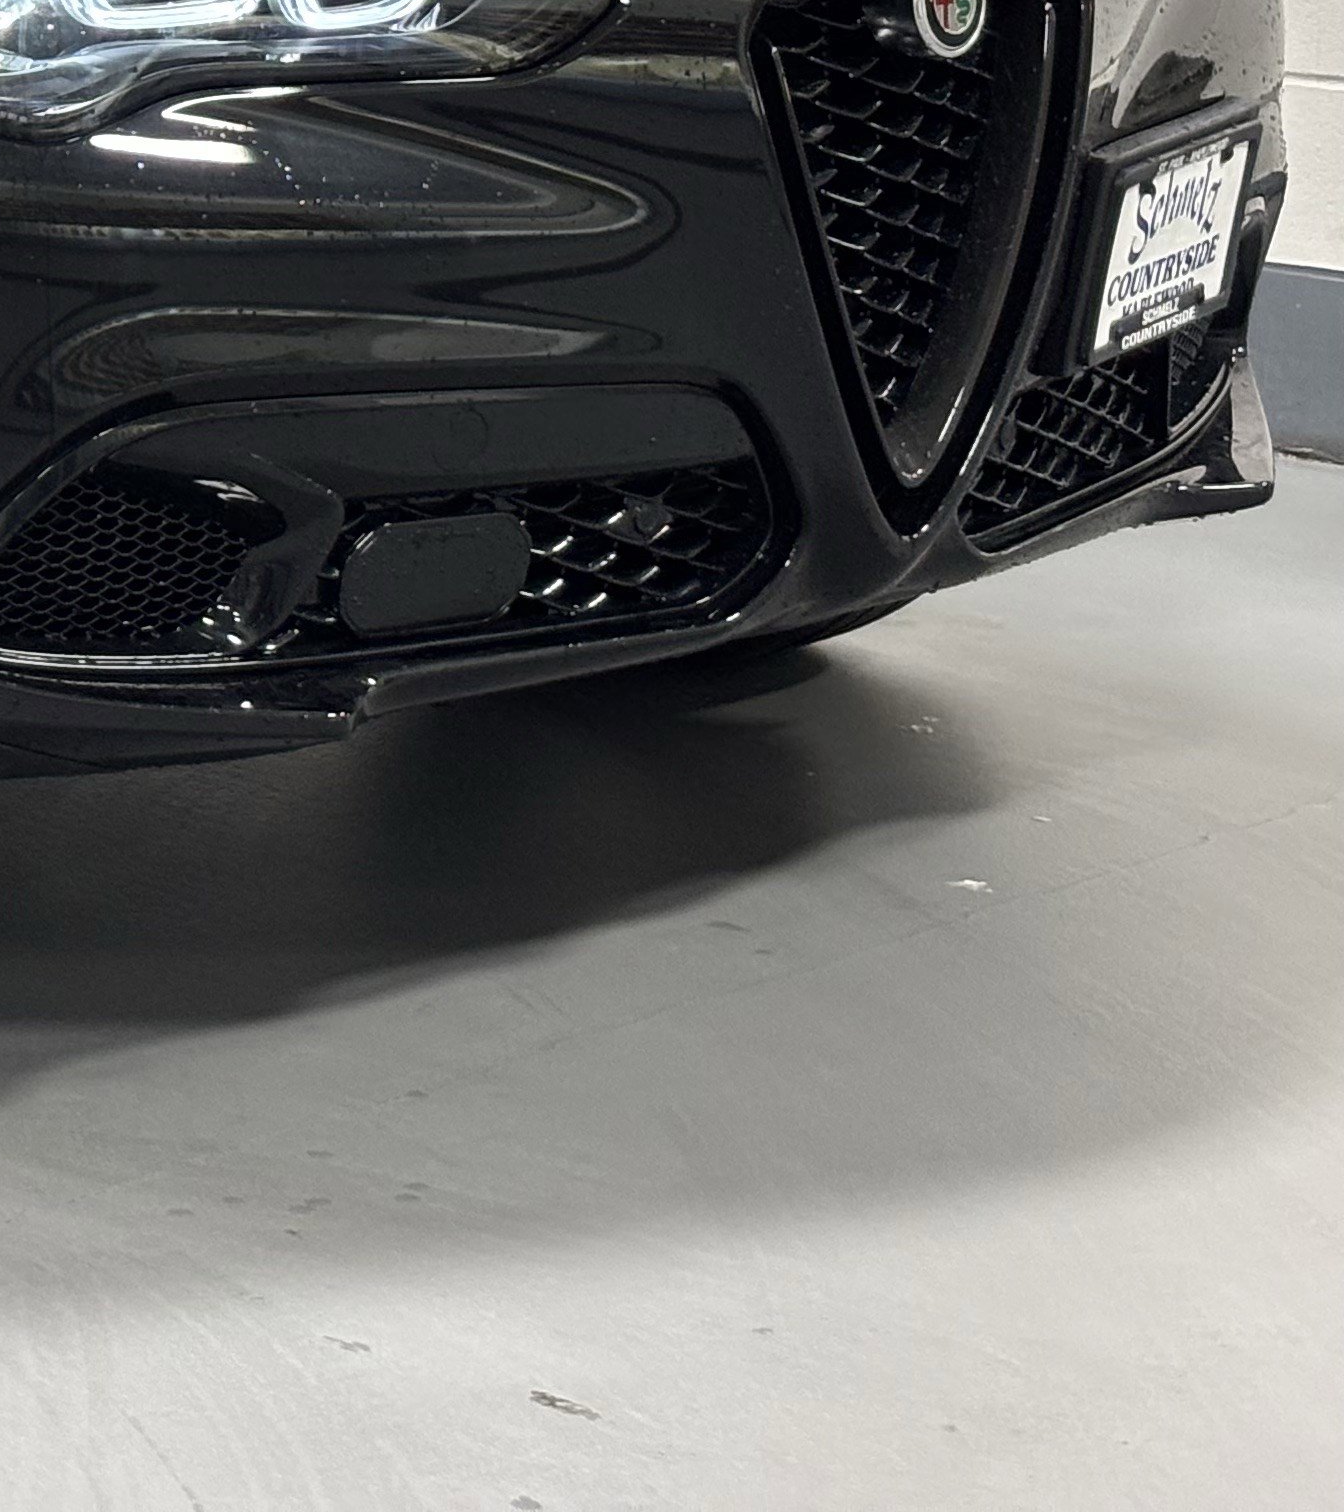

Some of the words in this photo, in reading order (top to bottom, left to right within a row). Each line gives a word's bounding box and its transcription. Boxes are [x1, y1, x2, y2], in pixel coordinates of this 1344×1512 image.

[1128, 157, 1222, 265] Schmelz
[1108, 233, 1220, 306] COUNTRYSIDE
[1122, 305, 1196, 349] COUNTRYSIDE
[1141, 297, 1180, 325] SCHMELZ
